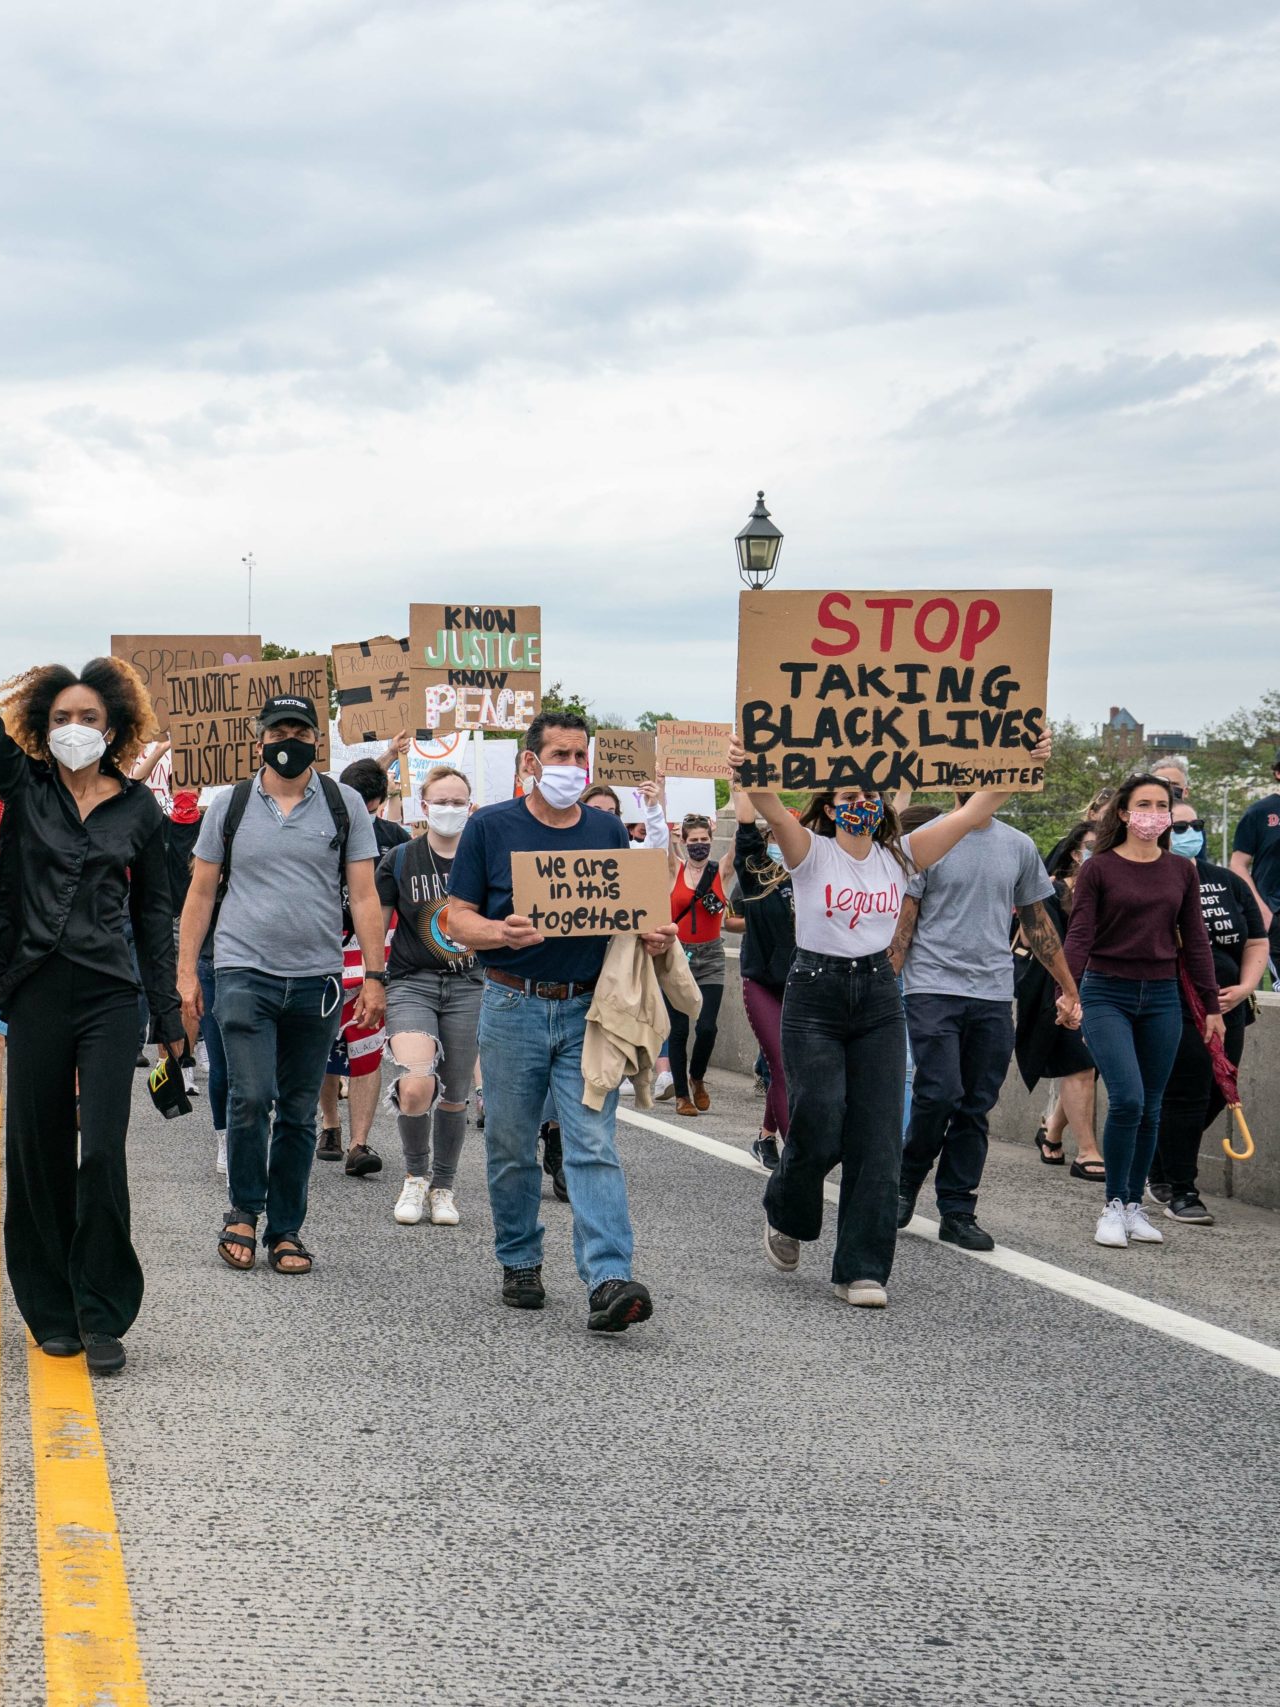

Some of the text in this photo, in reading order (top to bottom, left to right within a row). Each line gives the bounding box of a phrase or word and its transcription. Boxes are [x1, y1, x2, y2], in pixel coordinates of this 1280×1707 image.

[444, 606, 516, 633] KNOW
[811, 591, 1001, 662] STOP
[424, 629, 541, 670] JUSTICE
[448, 669, 508, 689] KNOW
[779, 662, 1021, 709] TAKING
[167, 672, 243, 717] INJUSTICE
[248, 669, 325, 711] ANYWHERE
[424, 684, 535, 731] PEACE
[179, 717, 257, 746] IS A THR
[659, 724, 731, 737] Defund the Police
[742, 700, 1045, 753] BLACK LIVES
[599, 737, 638, 753] BLACK
[671, 735, 719, 747] Invest in
[174, 740, 248, 788] JUSTICE
[598, 767, 651, 782] MATTER
[665, 757, 689, 772] End
[573, 857, 620, 881] are
[549, 879, 620, 900] in this
[1200, 895, 1220, 905] OST
[528, 903, 648, 936] together
[1216, 920, 1233, 931] ON
